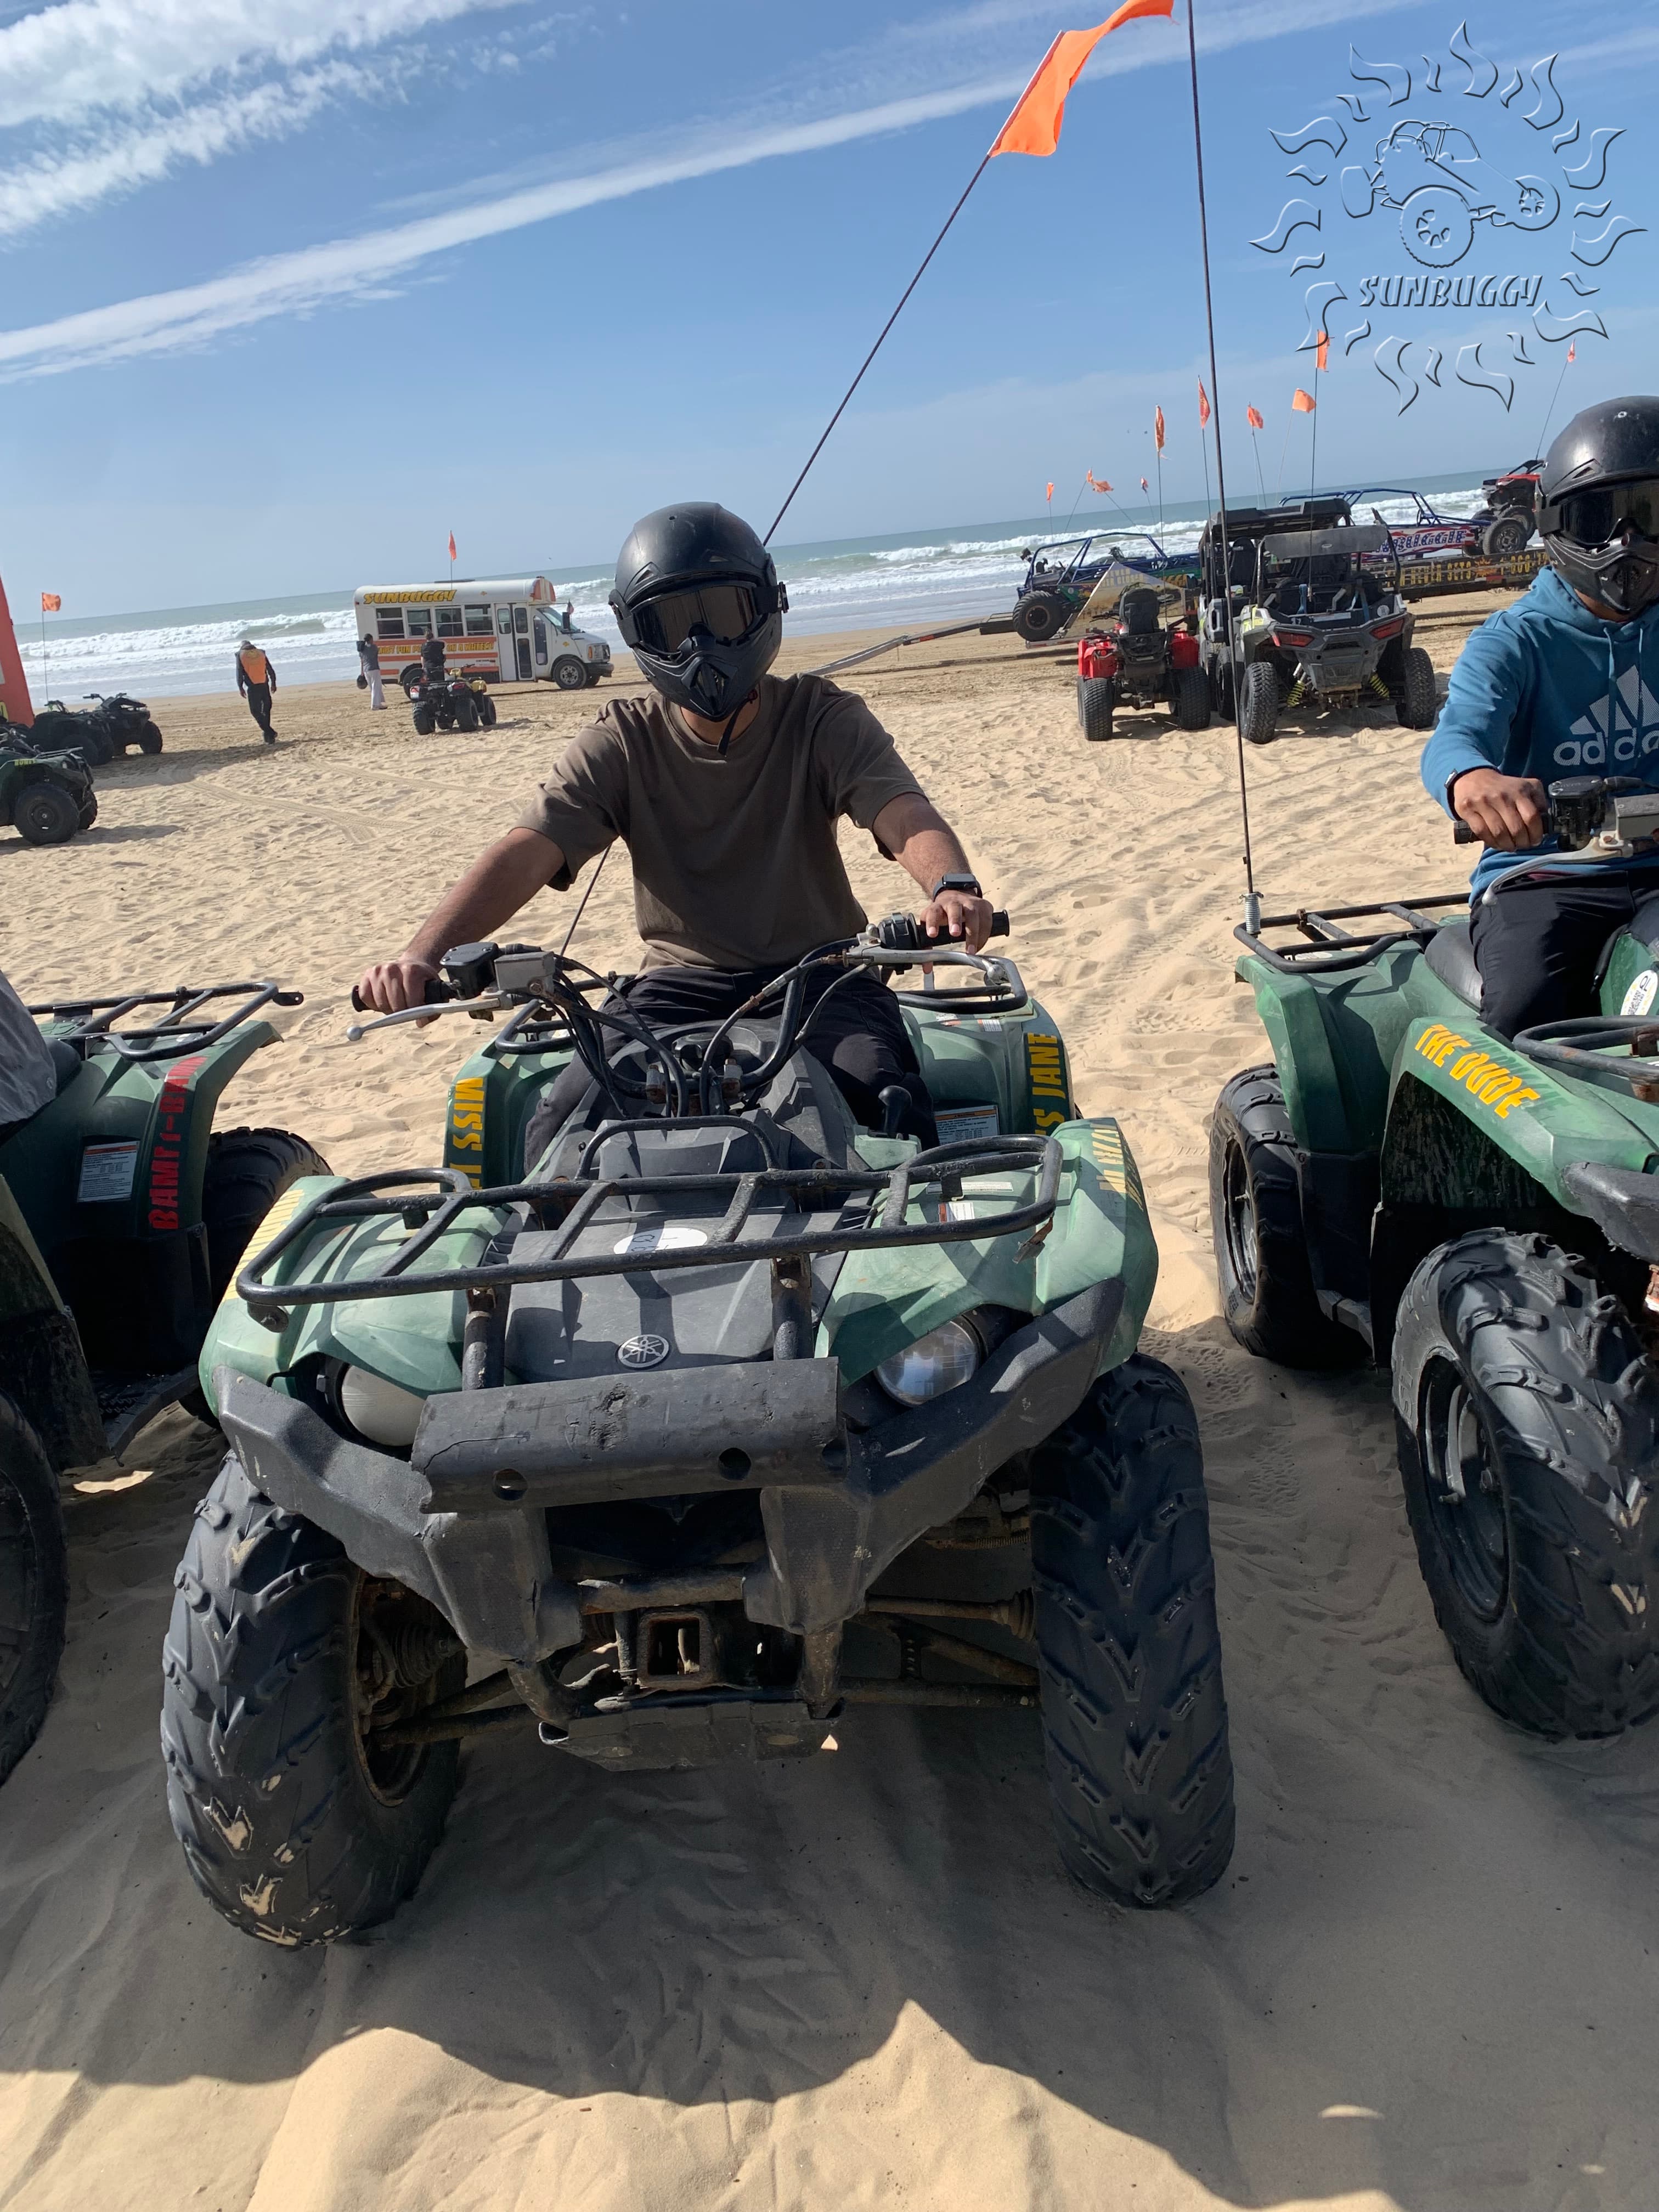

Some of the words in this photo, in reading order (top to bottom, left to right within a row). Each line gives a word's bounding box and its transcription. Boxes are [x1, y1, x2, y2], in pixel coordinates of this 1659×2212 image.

[364, 589, 457, 604] SUNBUGGY
[1553, 727, 1659, 766] adda
[1027, 1032, 1066, 1099] JANE
[1414, 1024, 1472, 1068] THE
[1449, 1052, 1541, 1119] DUDE
[452, 1077, 485, 1152] MISS
